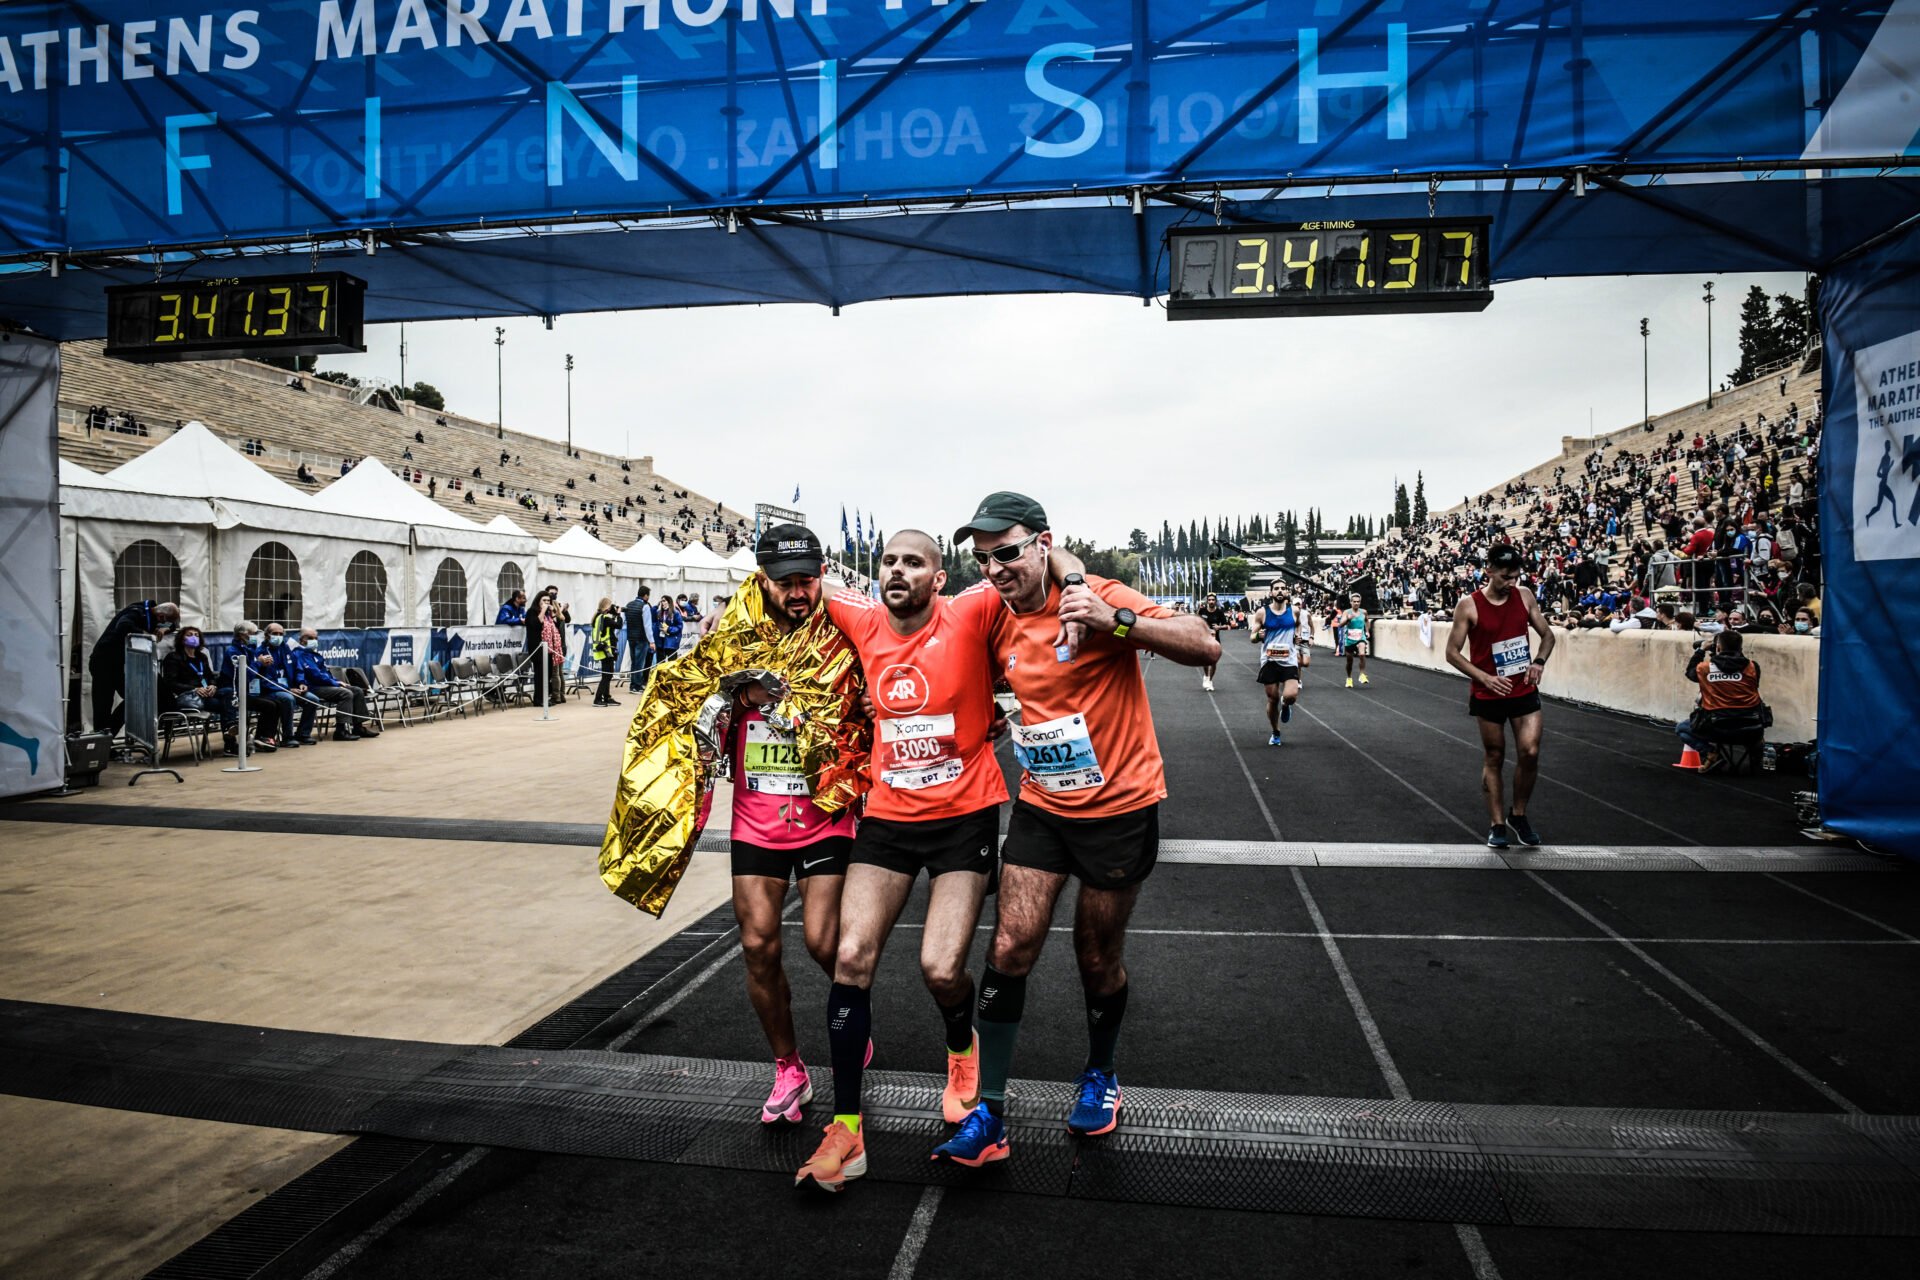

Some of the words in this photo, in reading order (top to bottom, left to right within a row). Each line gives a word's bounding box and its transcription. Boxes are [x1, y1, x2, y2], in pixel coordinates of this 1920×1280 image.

[165, 23, 1407, 215] FINISH
[1300, 220, 1355, 231] ALGE-TIMING
[1869, 416, 1884, 429] THE
[465, 640, 495, 650] Marathon
[496, 640, 502, 649] to
[503, 638, 522, 649] Athens
[315, 646, 359, 661] αραθώνιος
[1501, 647, 1527, 662] 14346
[1709, 673, 1741, 681] PHOTO
[892, 737, 941, 761] 13090
